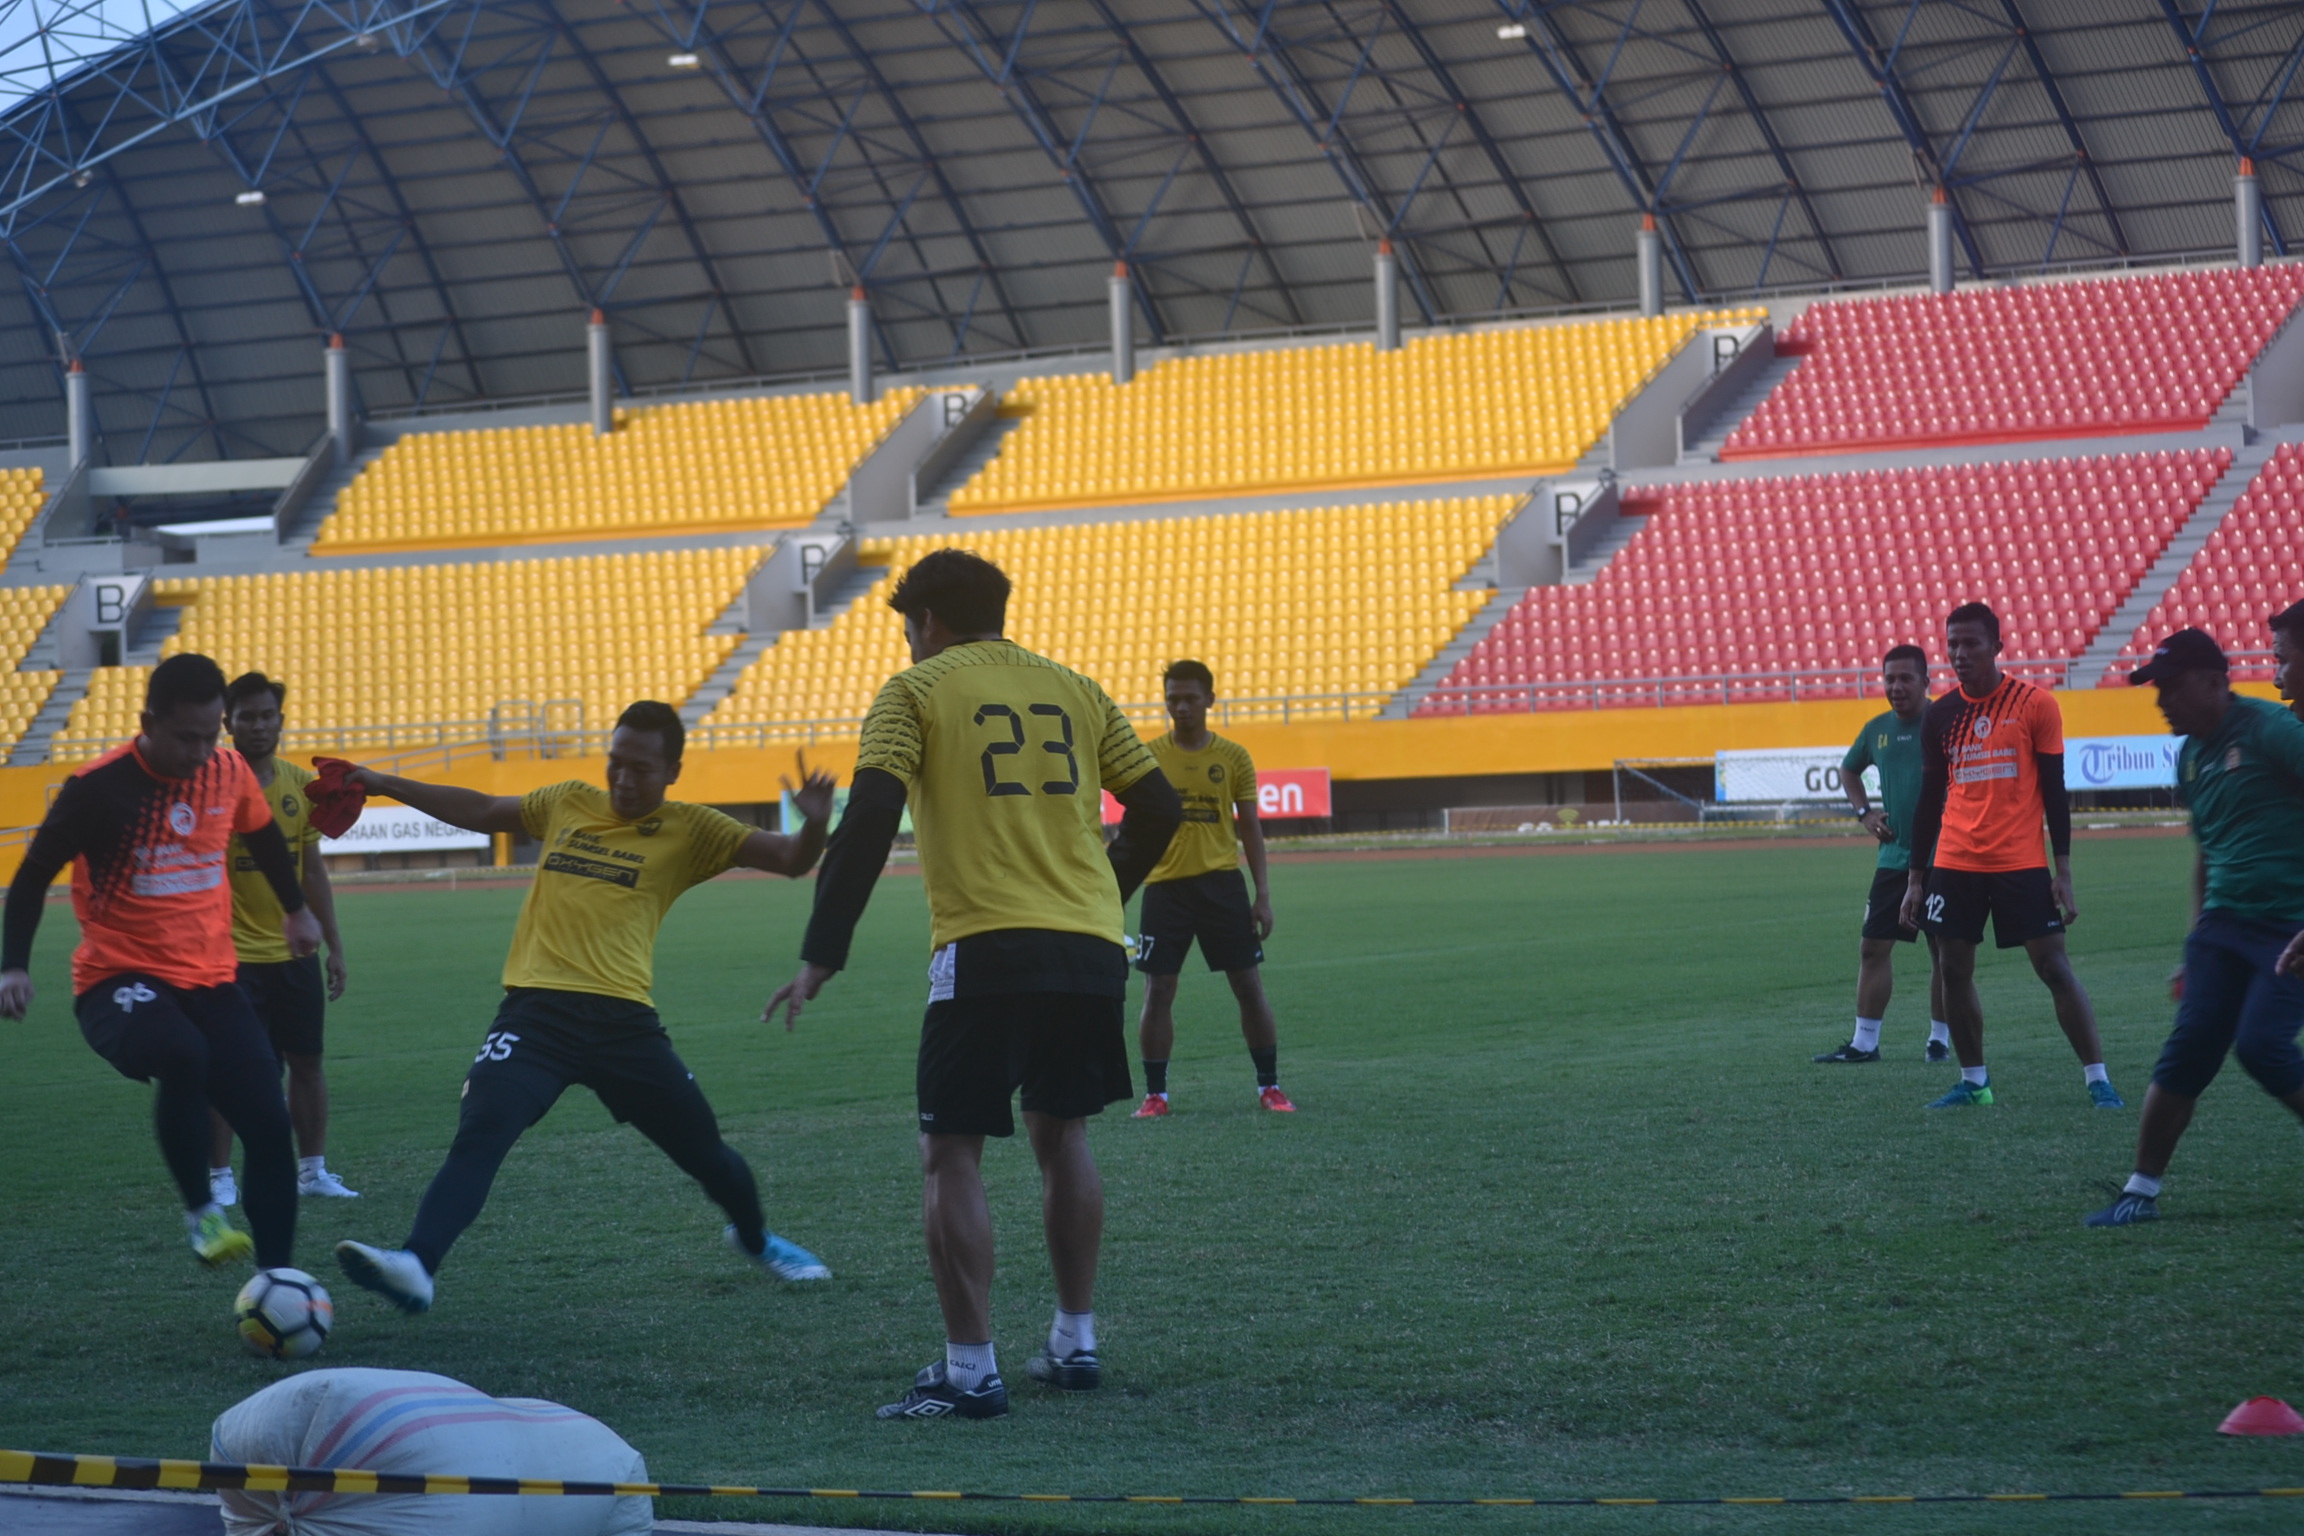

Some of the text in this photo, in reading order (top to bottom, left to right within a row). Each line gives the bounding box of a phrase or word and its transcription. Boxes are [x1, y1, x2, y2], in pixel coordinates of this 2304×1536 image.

[96, 584, 125, 623] B
[973, 703, 1080, 797] 23
[2079, 743, 2156, 785] Tribun
[1256, 783, 1305, 813] en
[392, 821, 420, 839] GAS
[610, 849, 647, 865] BABEL
[1924, 892, 1946, 923] 12
[112, 981, 158, 1014] 96
